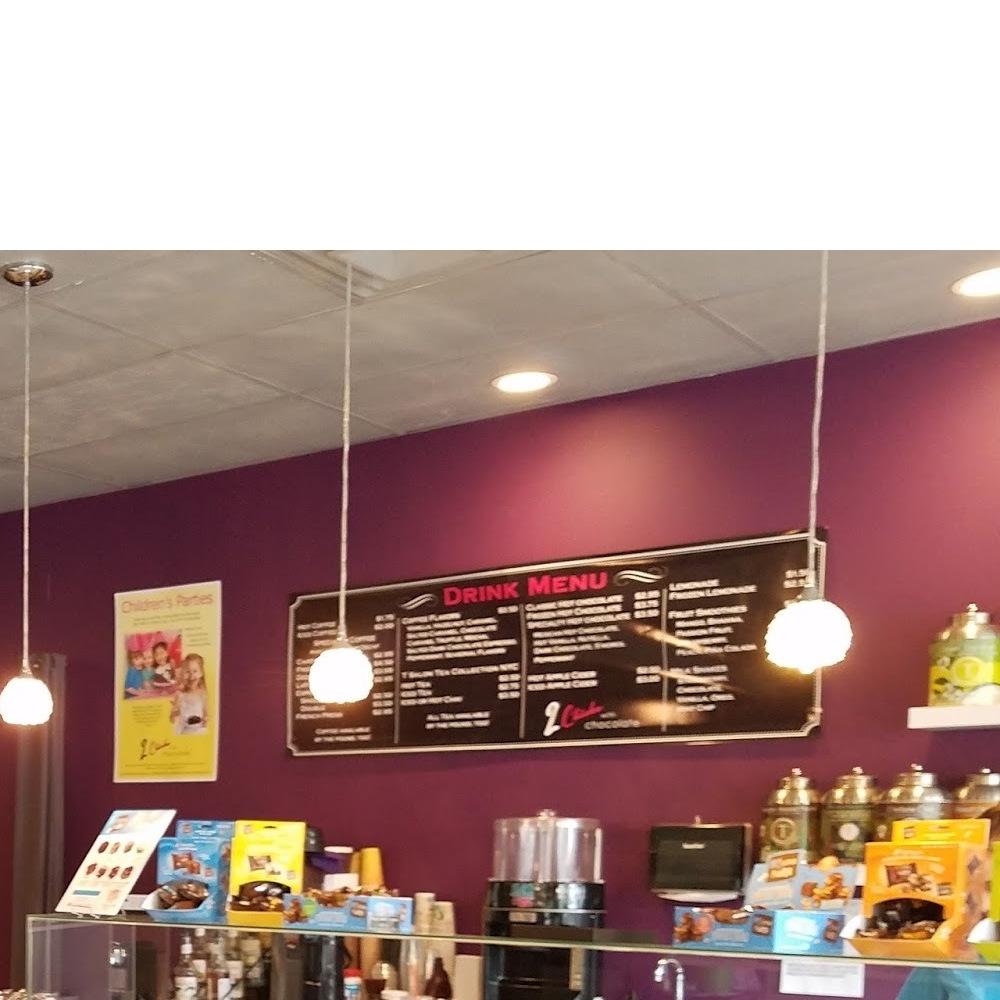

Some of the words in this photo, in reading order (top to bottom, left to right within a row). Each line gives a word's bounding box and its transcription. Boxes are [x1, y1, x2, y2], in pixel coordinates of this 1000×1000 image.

[443, 582, 519, 606] DRINK
[527, 572, 608, 596] MENU
[575, 594, 624, 605] CHOCOLATE
[574, 603, 623, 614] CHOCOLATE
[582, 611, 632, 623] CHOCOLATE
